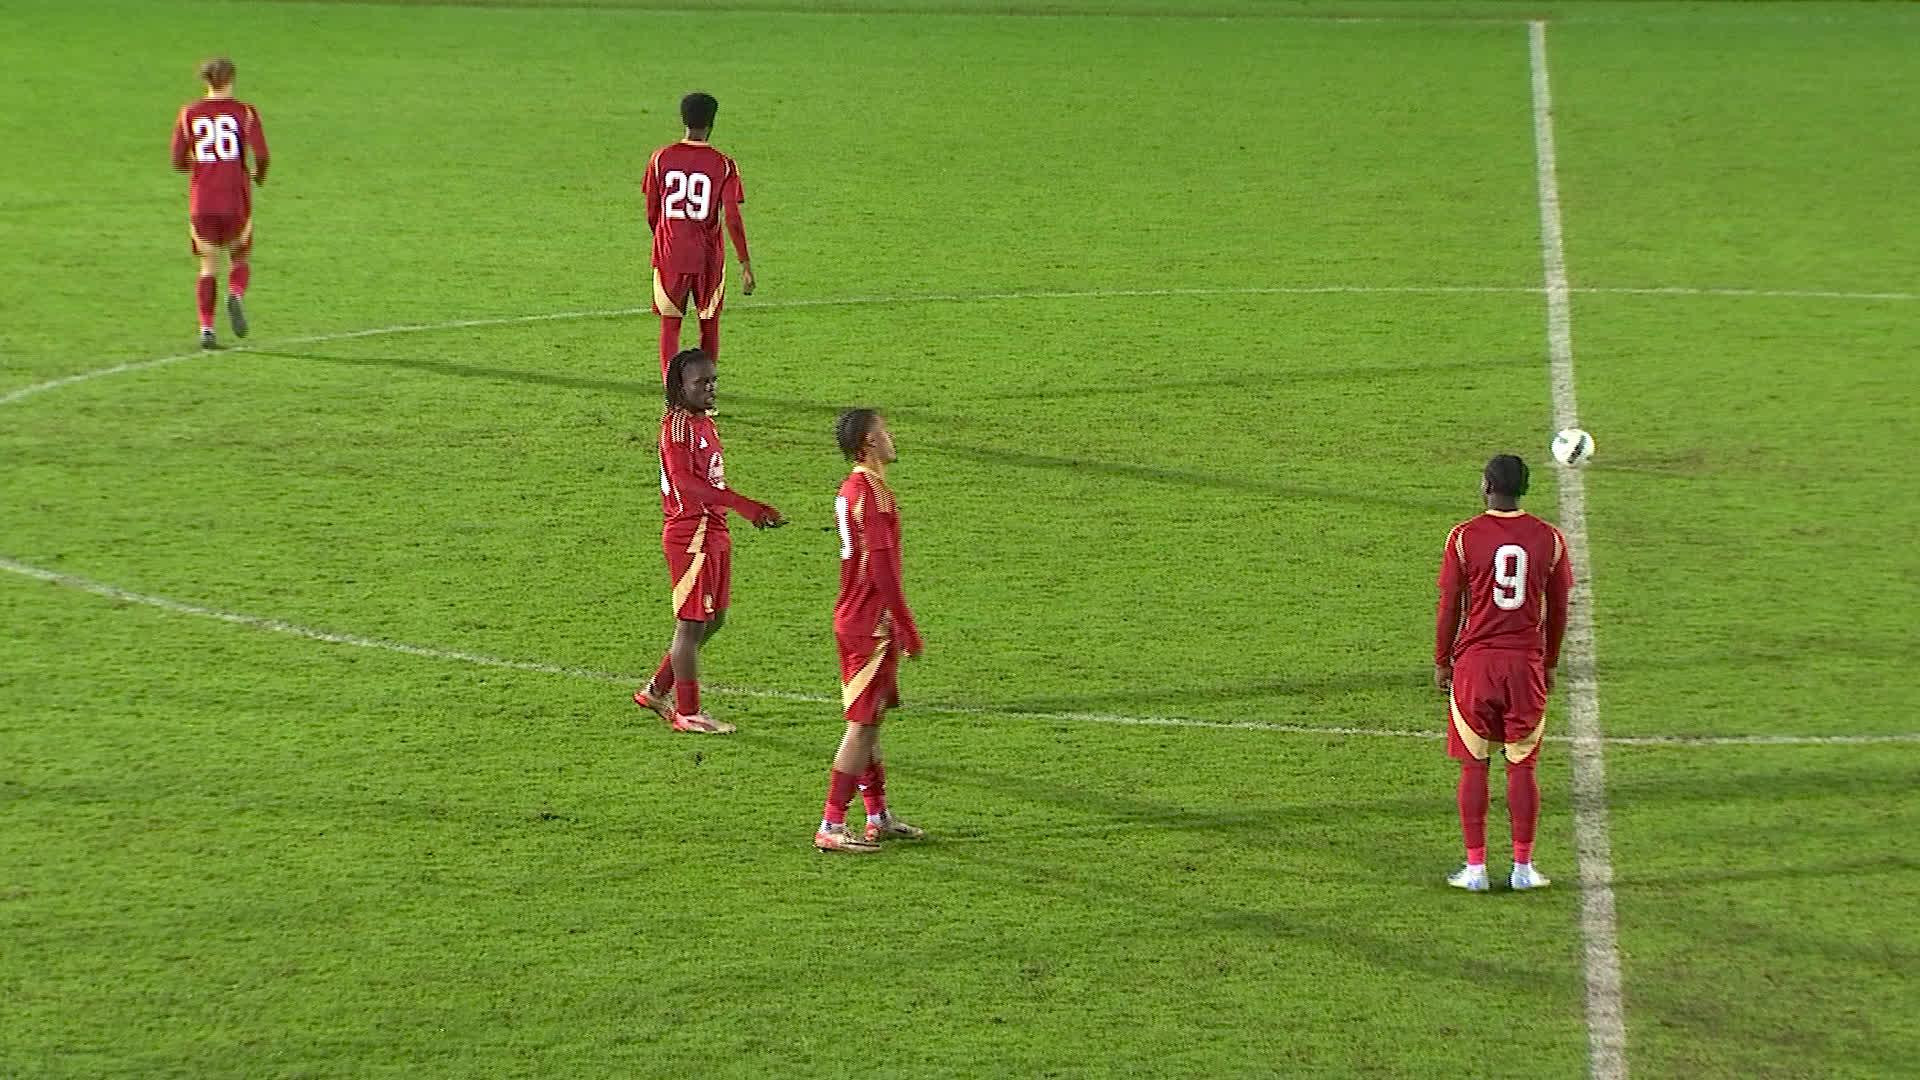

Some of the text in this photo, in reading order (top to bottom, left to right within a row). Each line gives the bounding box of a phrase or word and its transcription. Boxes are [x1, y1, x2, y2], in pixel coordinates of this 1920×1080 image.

[191, 114, 240, 162] 26
[665, 170, 711, 219] 29
[1493, 544, 1528, 611] 9
